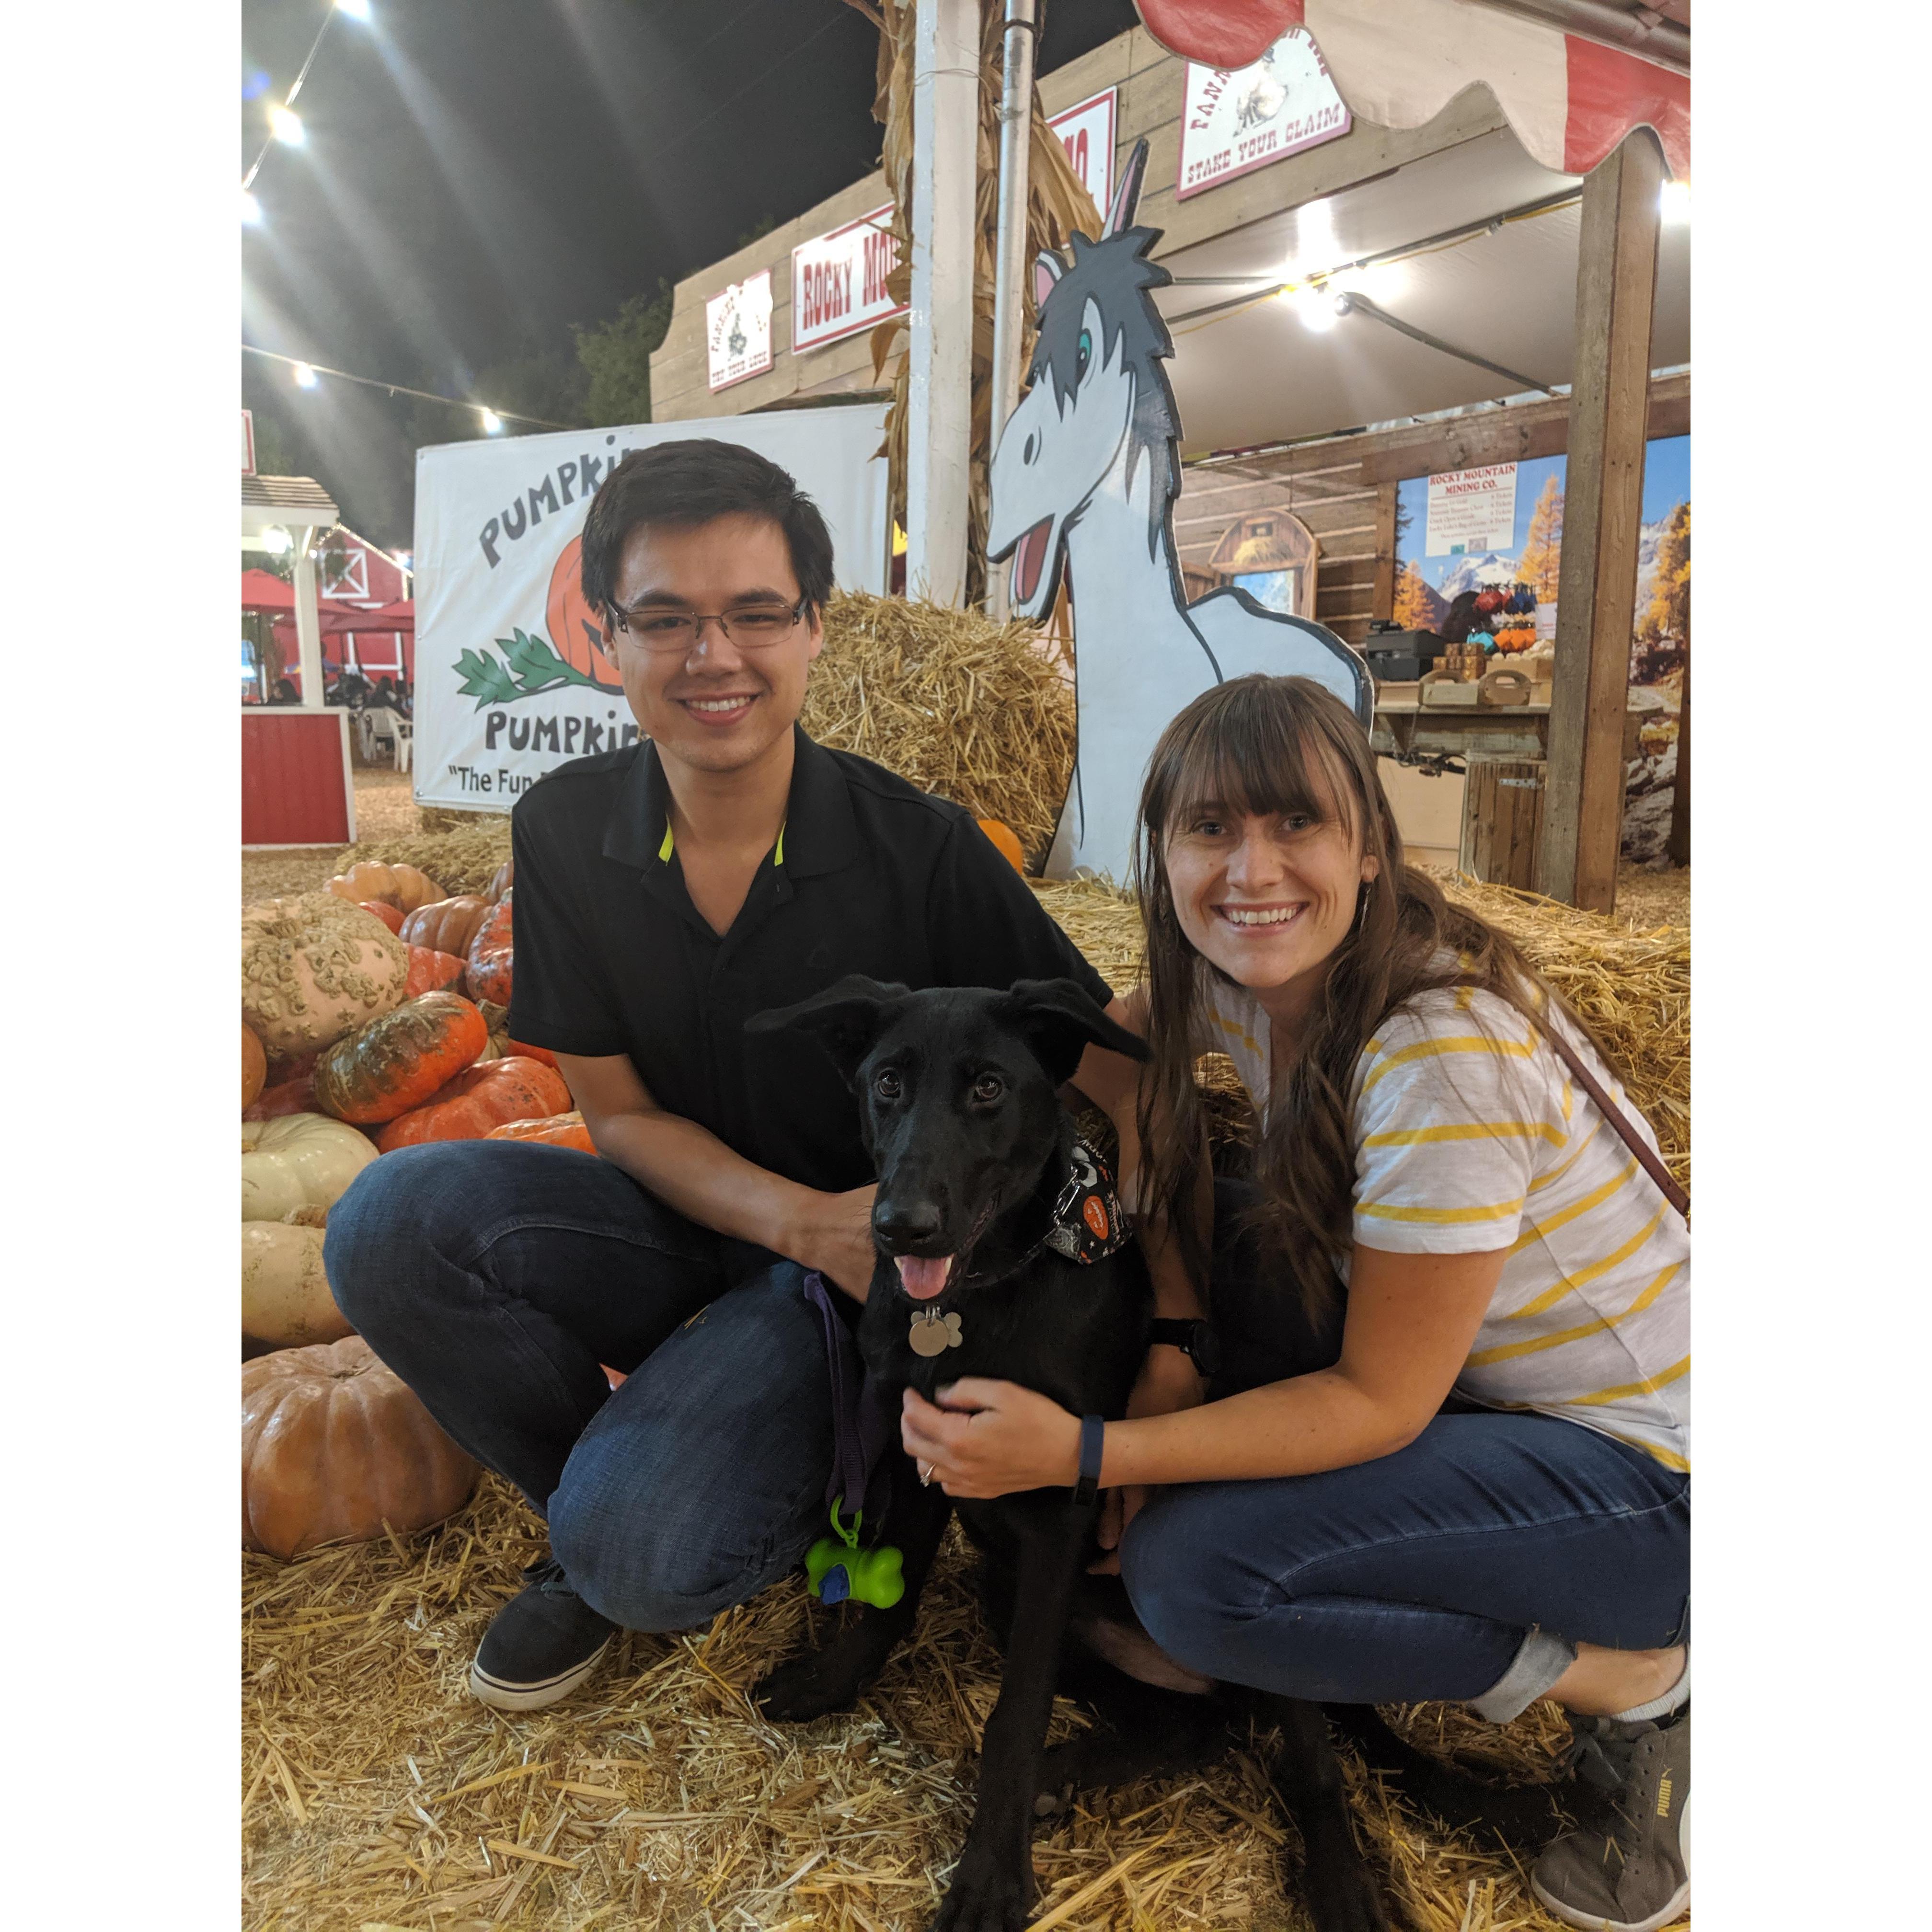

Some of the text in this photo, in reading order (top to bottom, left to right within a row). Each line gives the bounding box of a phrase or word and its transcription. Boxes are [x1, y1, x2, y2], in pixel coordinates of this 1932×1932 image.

[1187, 102, 1341, 183] STAKE YOUR CLAIM
[803, 255, 852, 330] ROCKY
[1430, 464, 1516, 485] ROCKY MOUNTAIN
[1445, 479, 1497, 495] MINING CO.
[498, 769, 533, 794] Fun
[1657, 1779, 1672, 1818] PUMA
